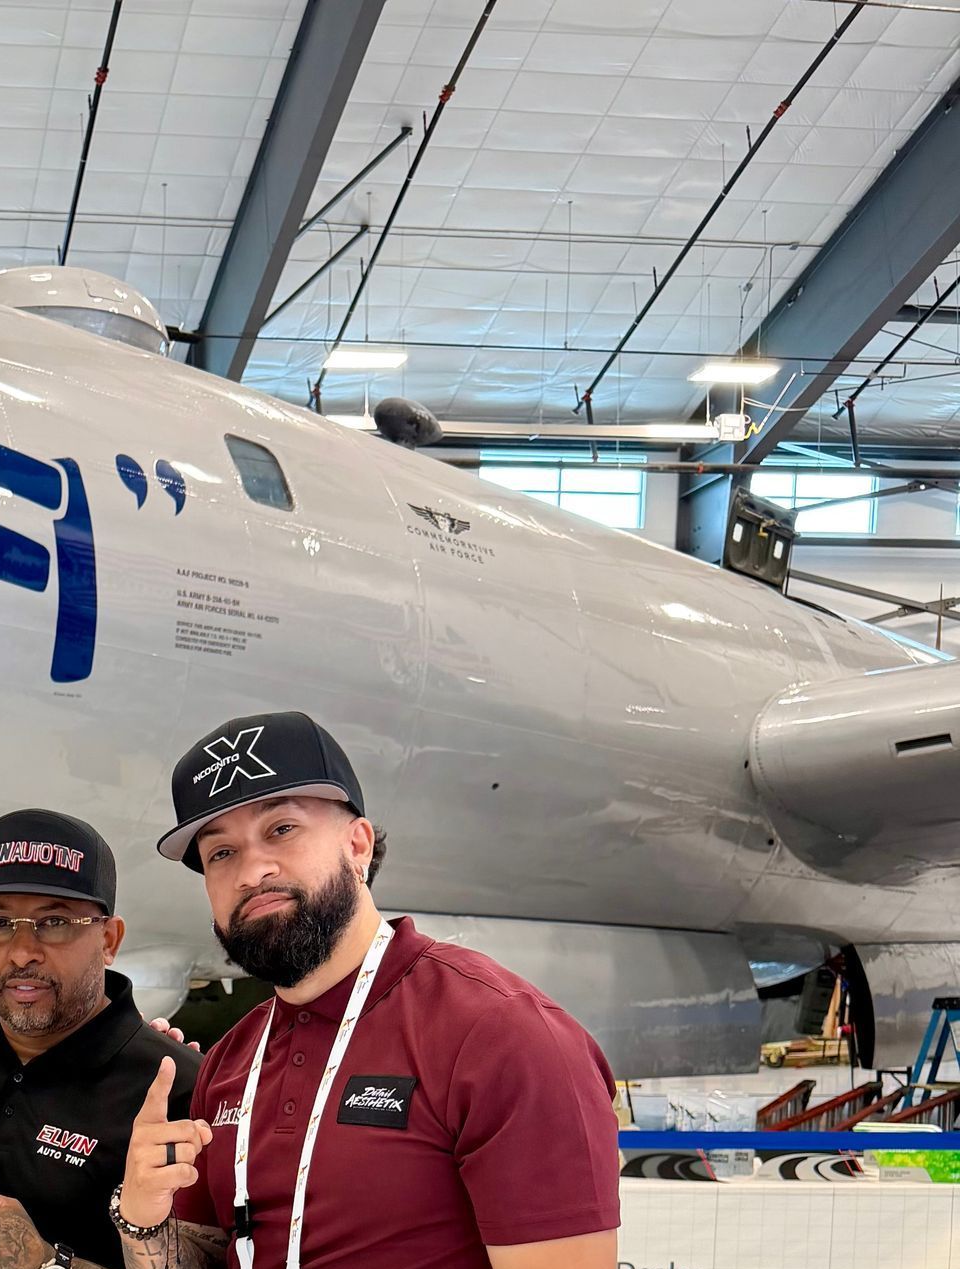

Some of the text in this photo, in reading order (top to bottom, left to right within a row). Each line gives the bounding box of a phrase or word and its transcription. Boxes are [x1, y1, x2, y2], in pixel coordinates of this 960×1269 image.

[407, 525, 495, 557] COMMEMORATIVE
[429, 543, 484, 564] AIR FORCE
[193, 753, 240, 785] INCOGNITO
[36, 1124, 98, 1156] ELVIN
[37, 1145, 86, 1167] AUTO TINT
